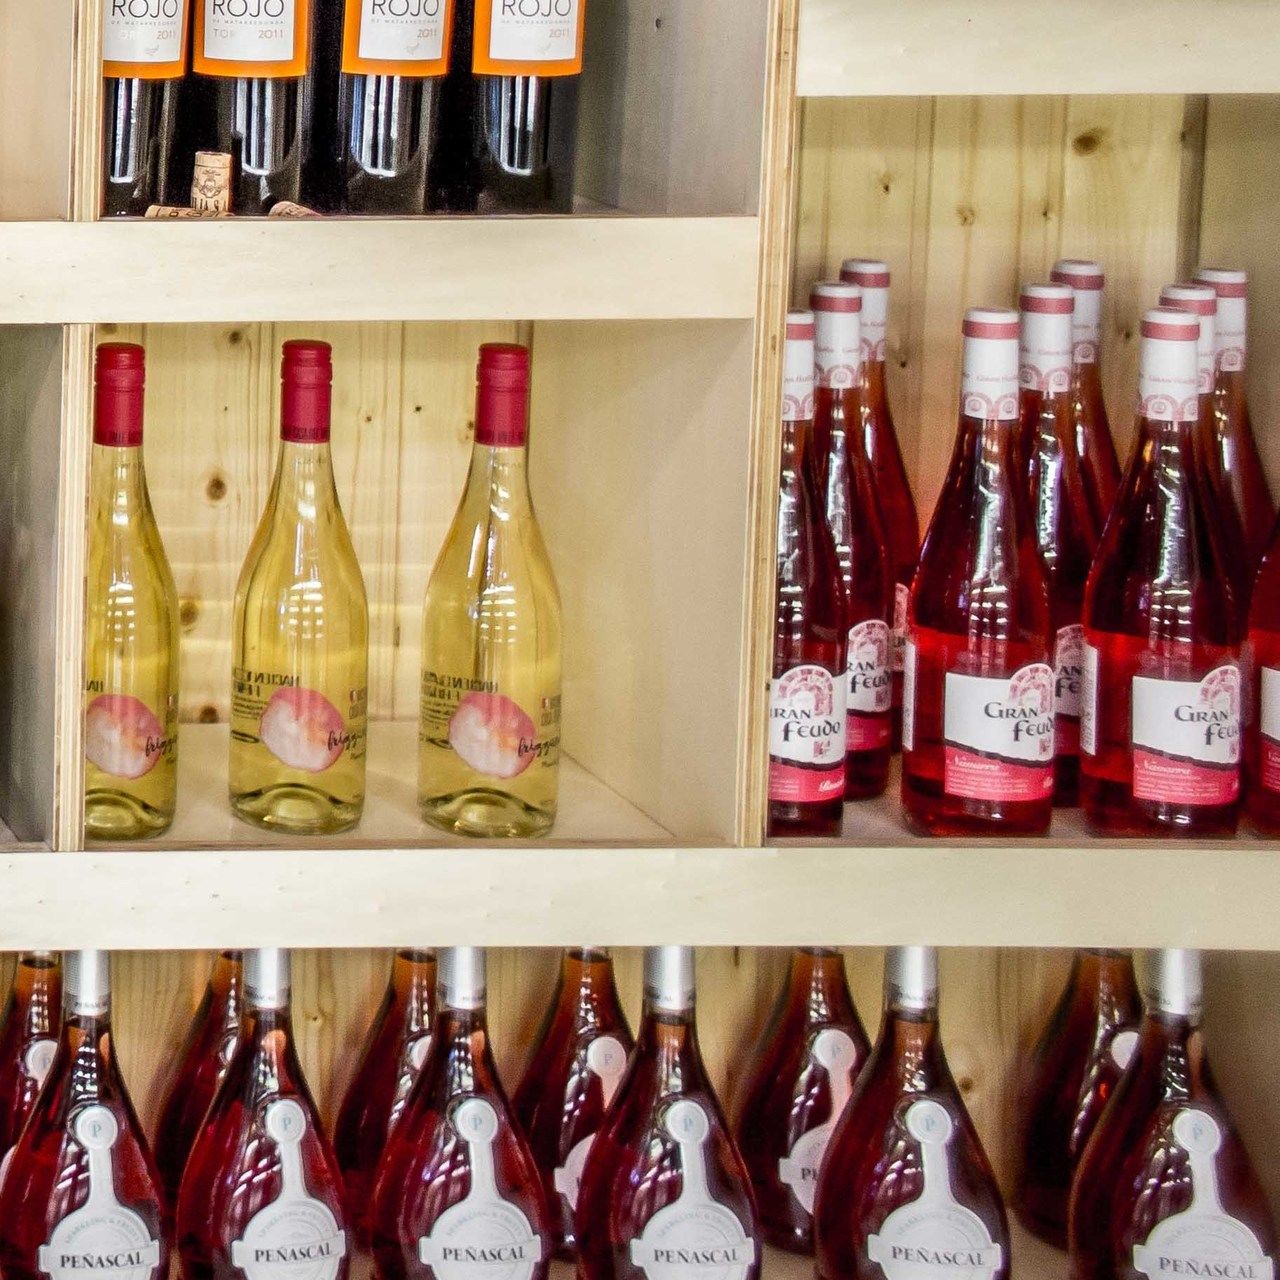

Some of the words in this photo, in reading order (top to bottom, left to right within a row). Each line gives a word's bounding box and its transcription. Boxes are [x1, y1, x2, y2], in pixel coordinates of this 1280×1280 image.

[258, 29, 283, 39] 2011
[984, 702, 1038, 719] GRAN
[1174, 705, 1228, 722] GRAN
[61, 1251, 144, 1269] PEÑASCAL
[255, 1242, 332, 1262] PEÑASCAL
[443, 1245, 525, 1262] PEÑASCAL
[654, 1247, 739, 1265] PEÑASCAL
[892, 1245, 984, 1266] PEÑASCAL
[1160, 1256, 1257, 1279] PEÑASCAL
